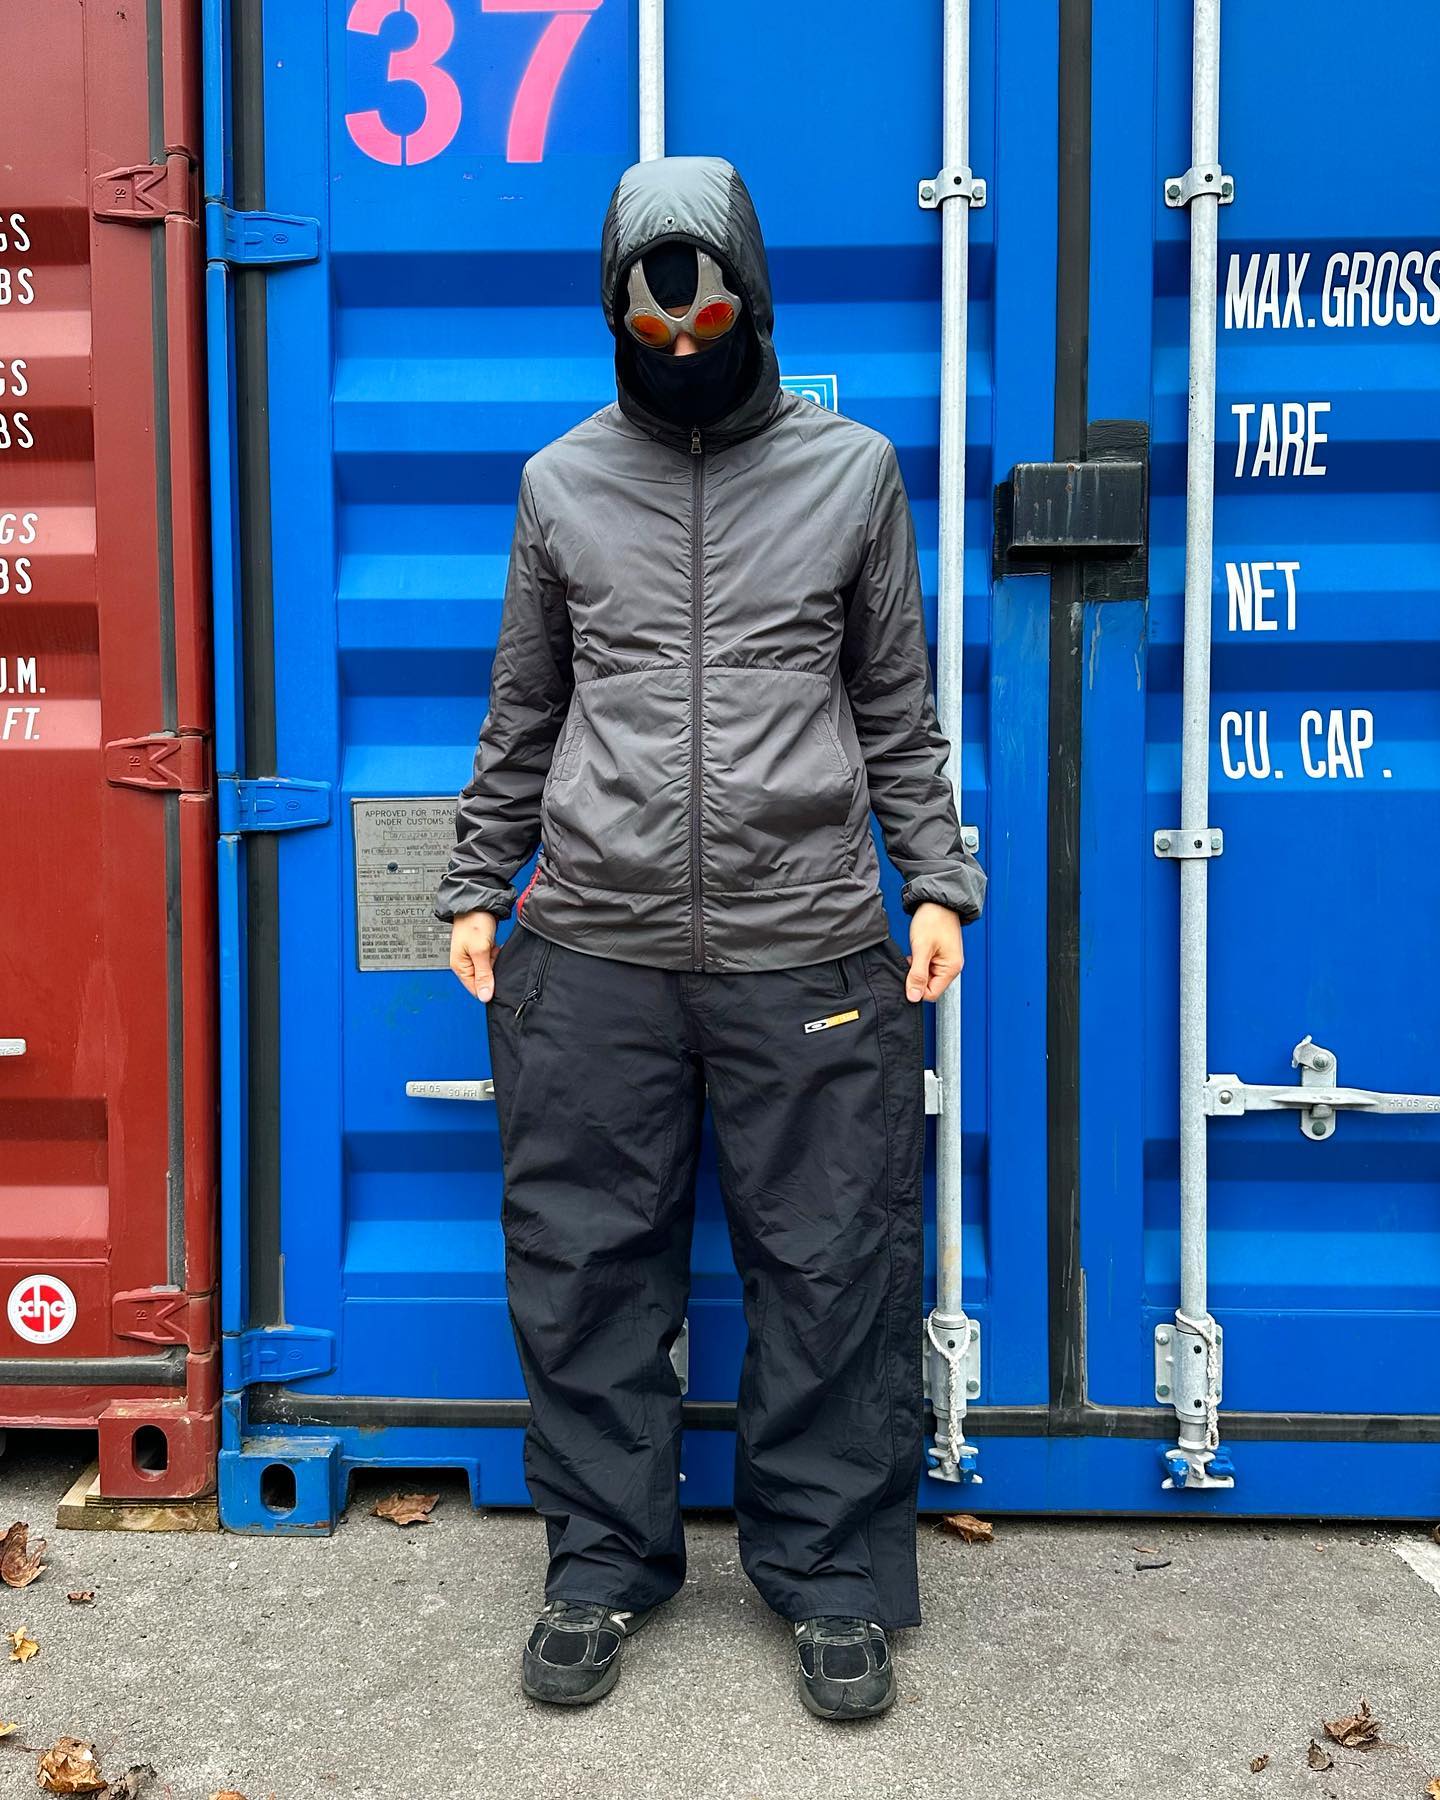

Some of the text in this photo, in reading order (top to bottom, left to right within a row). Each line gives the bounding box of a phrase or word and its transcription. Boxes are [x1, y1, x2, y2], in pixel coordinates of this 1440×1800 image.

[345, 0, 603, 166] 37
[1231, 402, 1331, 477] TARE
[1225, 561, 1300, 631] NET
[1220, 711, 1284, 779] CU.
[365, 809, 407, 818] APPROVED
[411, 809, 427, 817] FOR
[375, 818, 402, 826] UNDER
[406, 817, 444, 826] CUSTOMS
[395, 908, 426, 916] SAFETY
